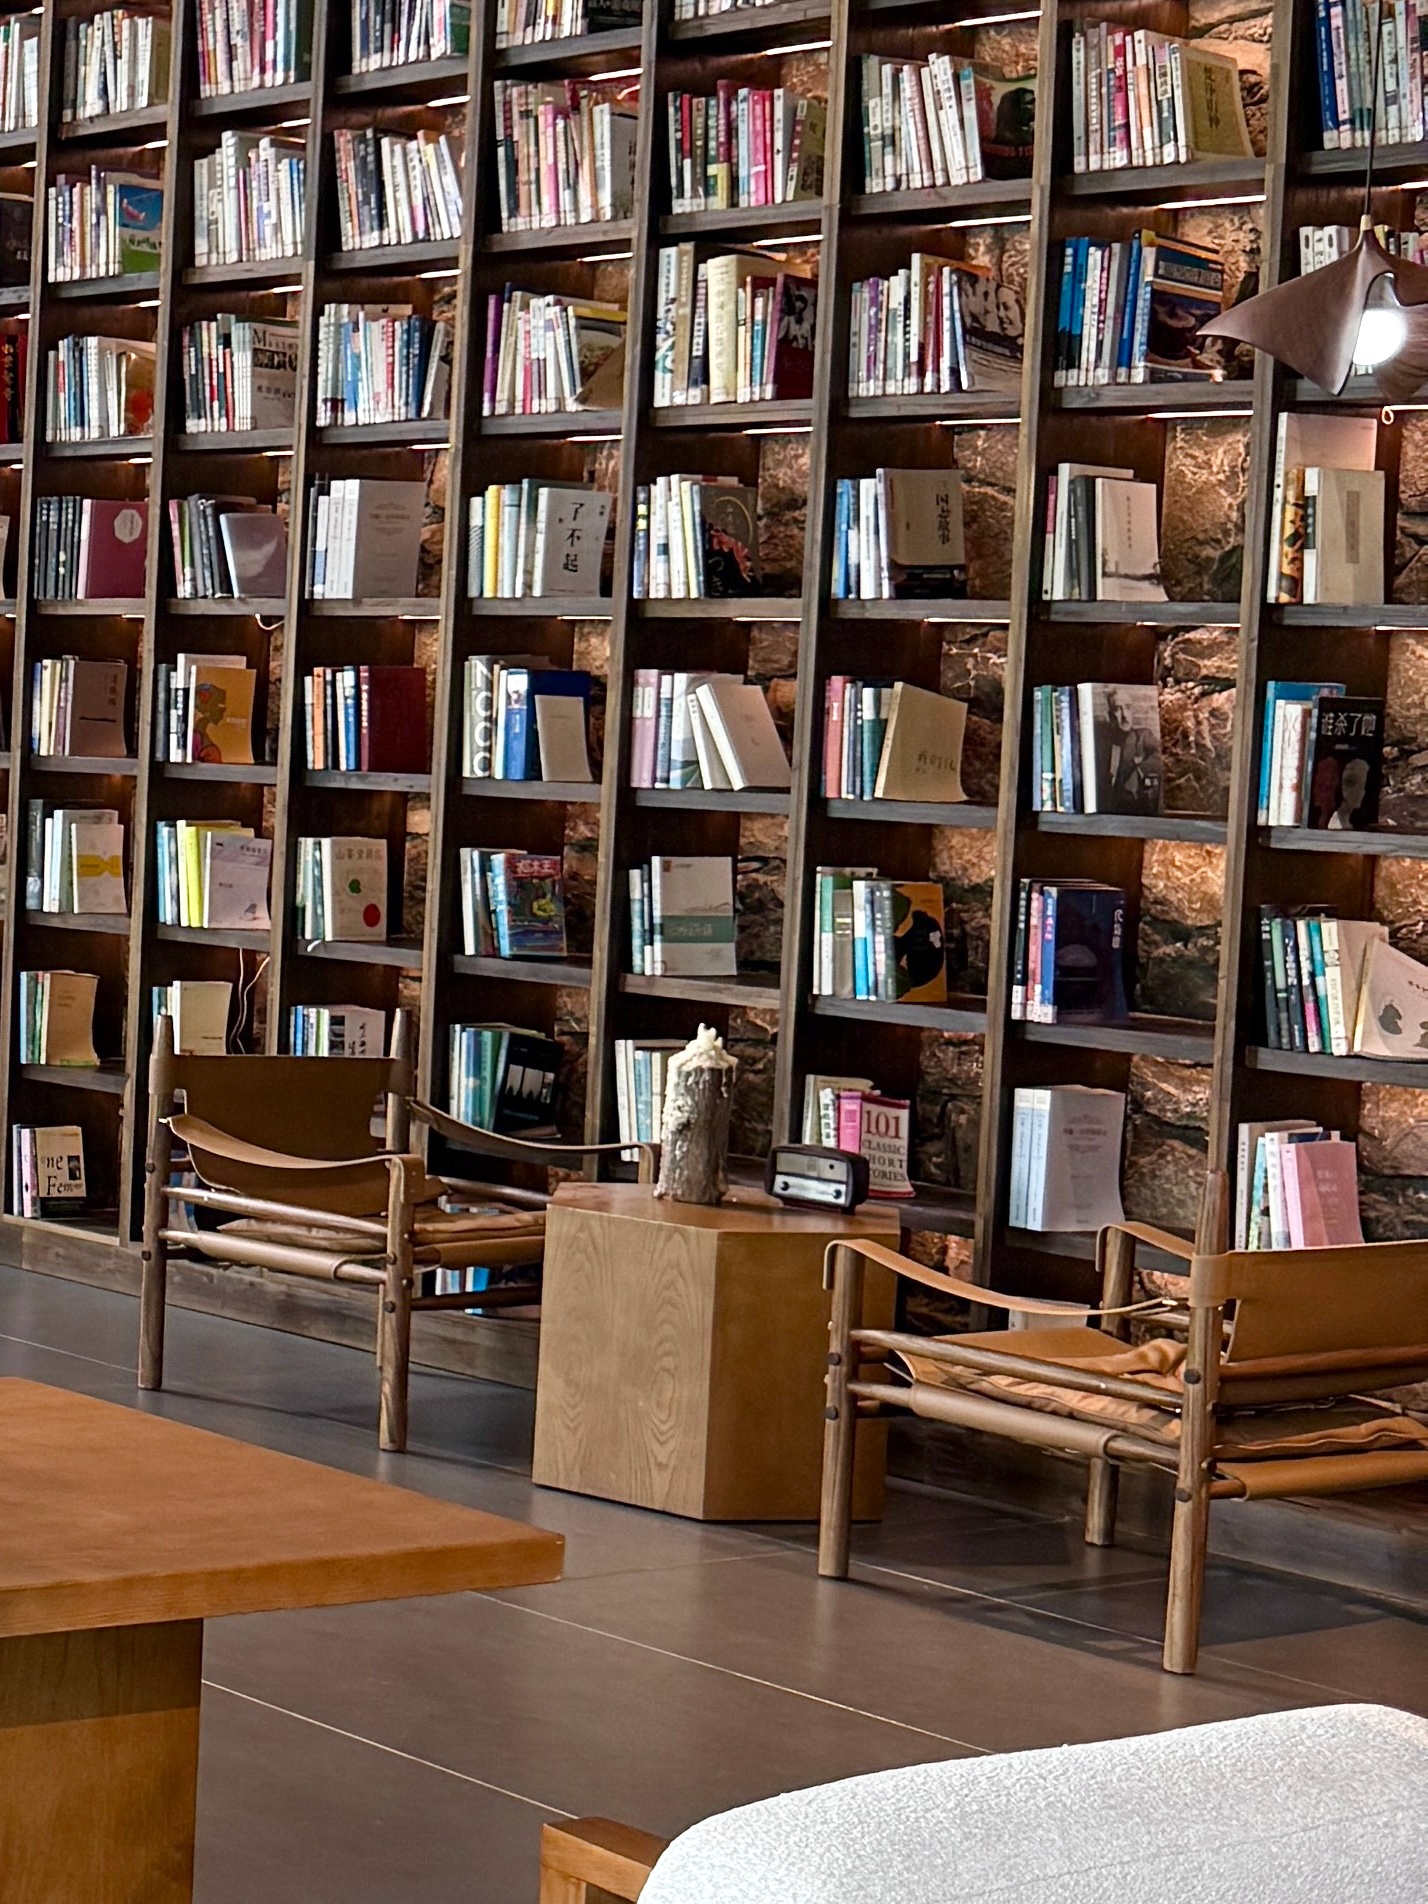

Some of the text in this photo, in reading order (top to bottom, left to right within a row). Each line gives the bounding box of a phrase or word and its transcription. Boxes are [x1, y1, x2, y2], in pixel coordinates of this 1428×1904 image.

[562, 501, 585, 573] 了不起
[864, 1109, 902, 1140] 101
[863, 1138, 906, 1157] CLASSIC
[868, 1152, 906, 1170] HORT
